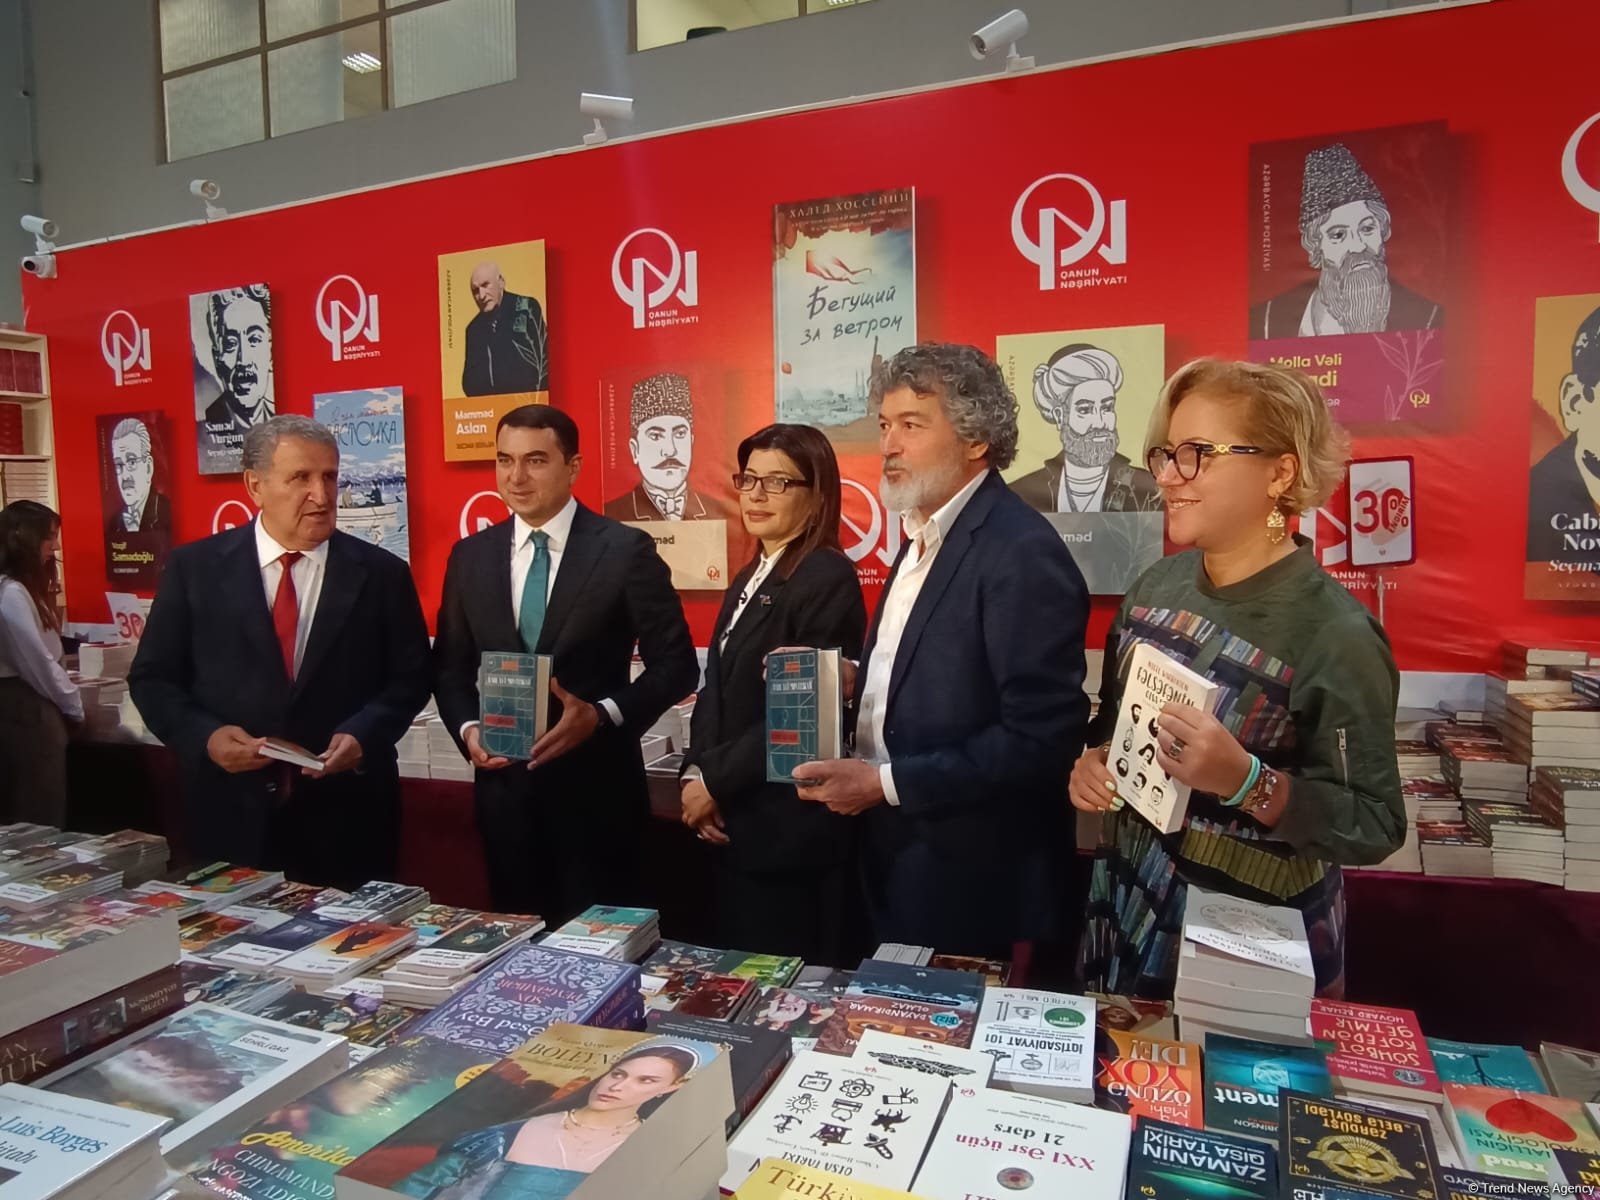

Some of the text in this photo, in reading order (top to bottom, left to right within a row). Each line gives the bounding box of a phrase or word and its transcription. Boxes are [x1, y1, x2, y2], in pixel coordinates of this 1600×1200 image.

[1060, 268, 1100, 280] QANUN
[1060, 276, 1128, 290] NƏŞRİYYATI
[806, 285, 897, 320] Бегущий
[648, 310, 678, 320] QANUN
[833, 315, 903, 340] ветром
[1316, 353, 1342, 367] Vəli
[455, 422, 487, 435] Aslan
[1330, 571, 1366, 579] ANUN
[456, 1011, 494, 1028] Bəy
[985, 1033, 1083, 1055] İQTİSADİYYAT 101
[1323, 1029, 1417, 1051] KOFEDƏN
[1340, 1041, 1420, 1066] SÖHBƏT
[1095, 1056, 1190, 1091] YOX
[1107, 1081, 1192, 1107] ÖZÜNƏ
[0, 1115, 109, 1154] Luis Borges
[994, 1122, 1065, 1146] 21 dərs
[1367, 1117, 1404, 1133] BELƏ
[956, 1133, 1095, 1172] XXI Əsr üçün
[1144, 1130, 1265, 1165] QISA TARİXİ
[1143, 1143, 1267, 1182] ZAMANIN
[209, 1158, 262, 1194] NGOZI
